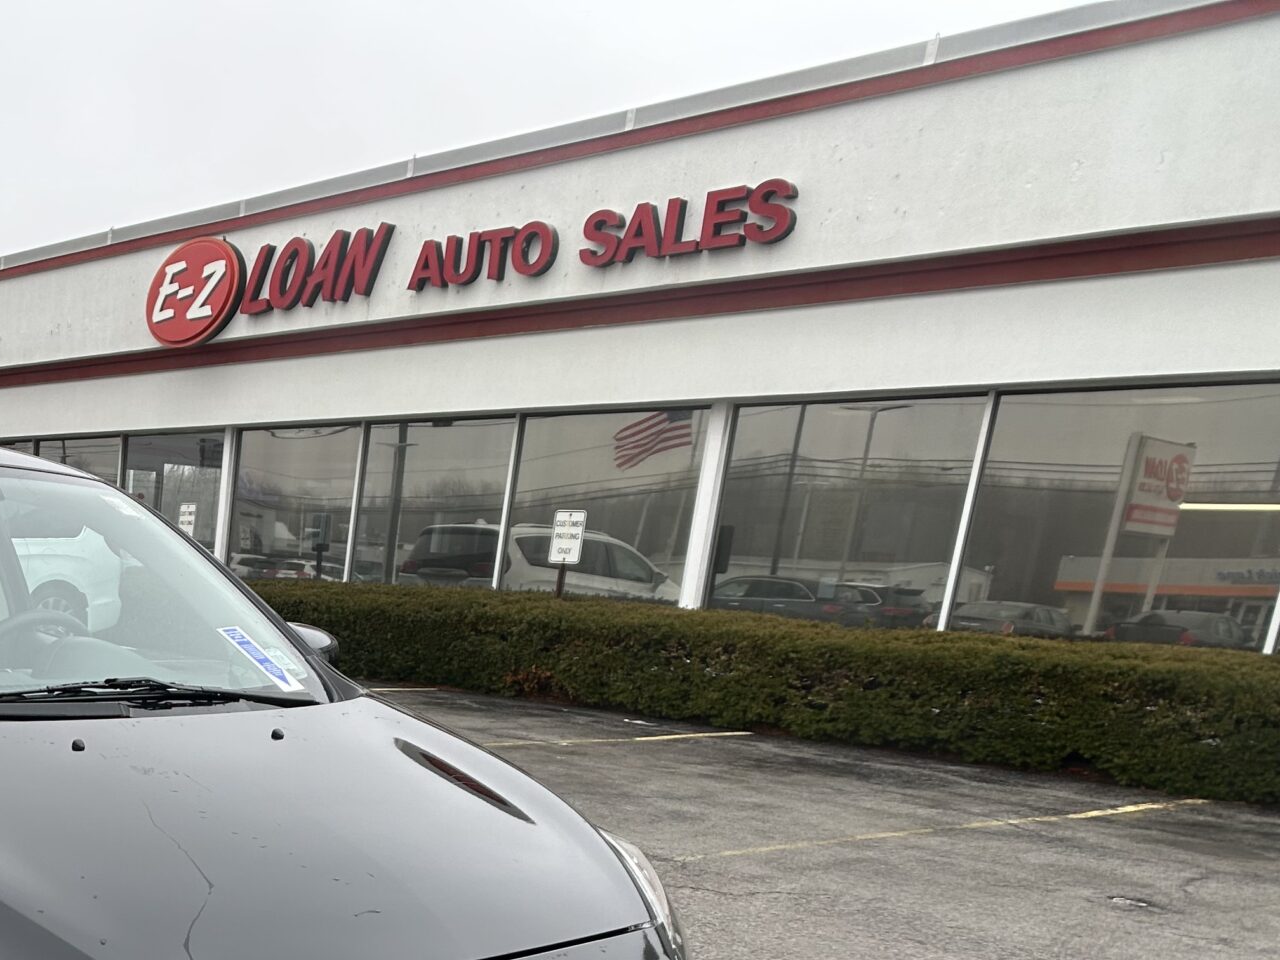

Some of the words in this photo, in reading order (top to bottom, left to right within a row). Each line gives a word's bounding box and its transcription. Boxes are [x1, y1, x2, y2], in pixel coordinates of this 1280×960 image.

[152, 260, 227, 323] E-Z
[239, 222, 396, 315] LOAN
[408, 220, 559, 292] AUTO
[578, 178, 799, 268] SALES
[555, 520, 584, 528] CUSTOMER
[554, 532, 580, 540] PARKING
[557, 547, 572, 555] ONLY
